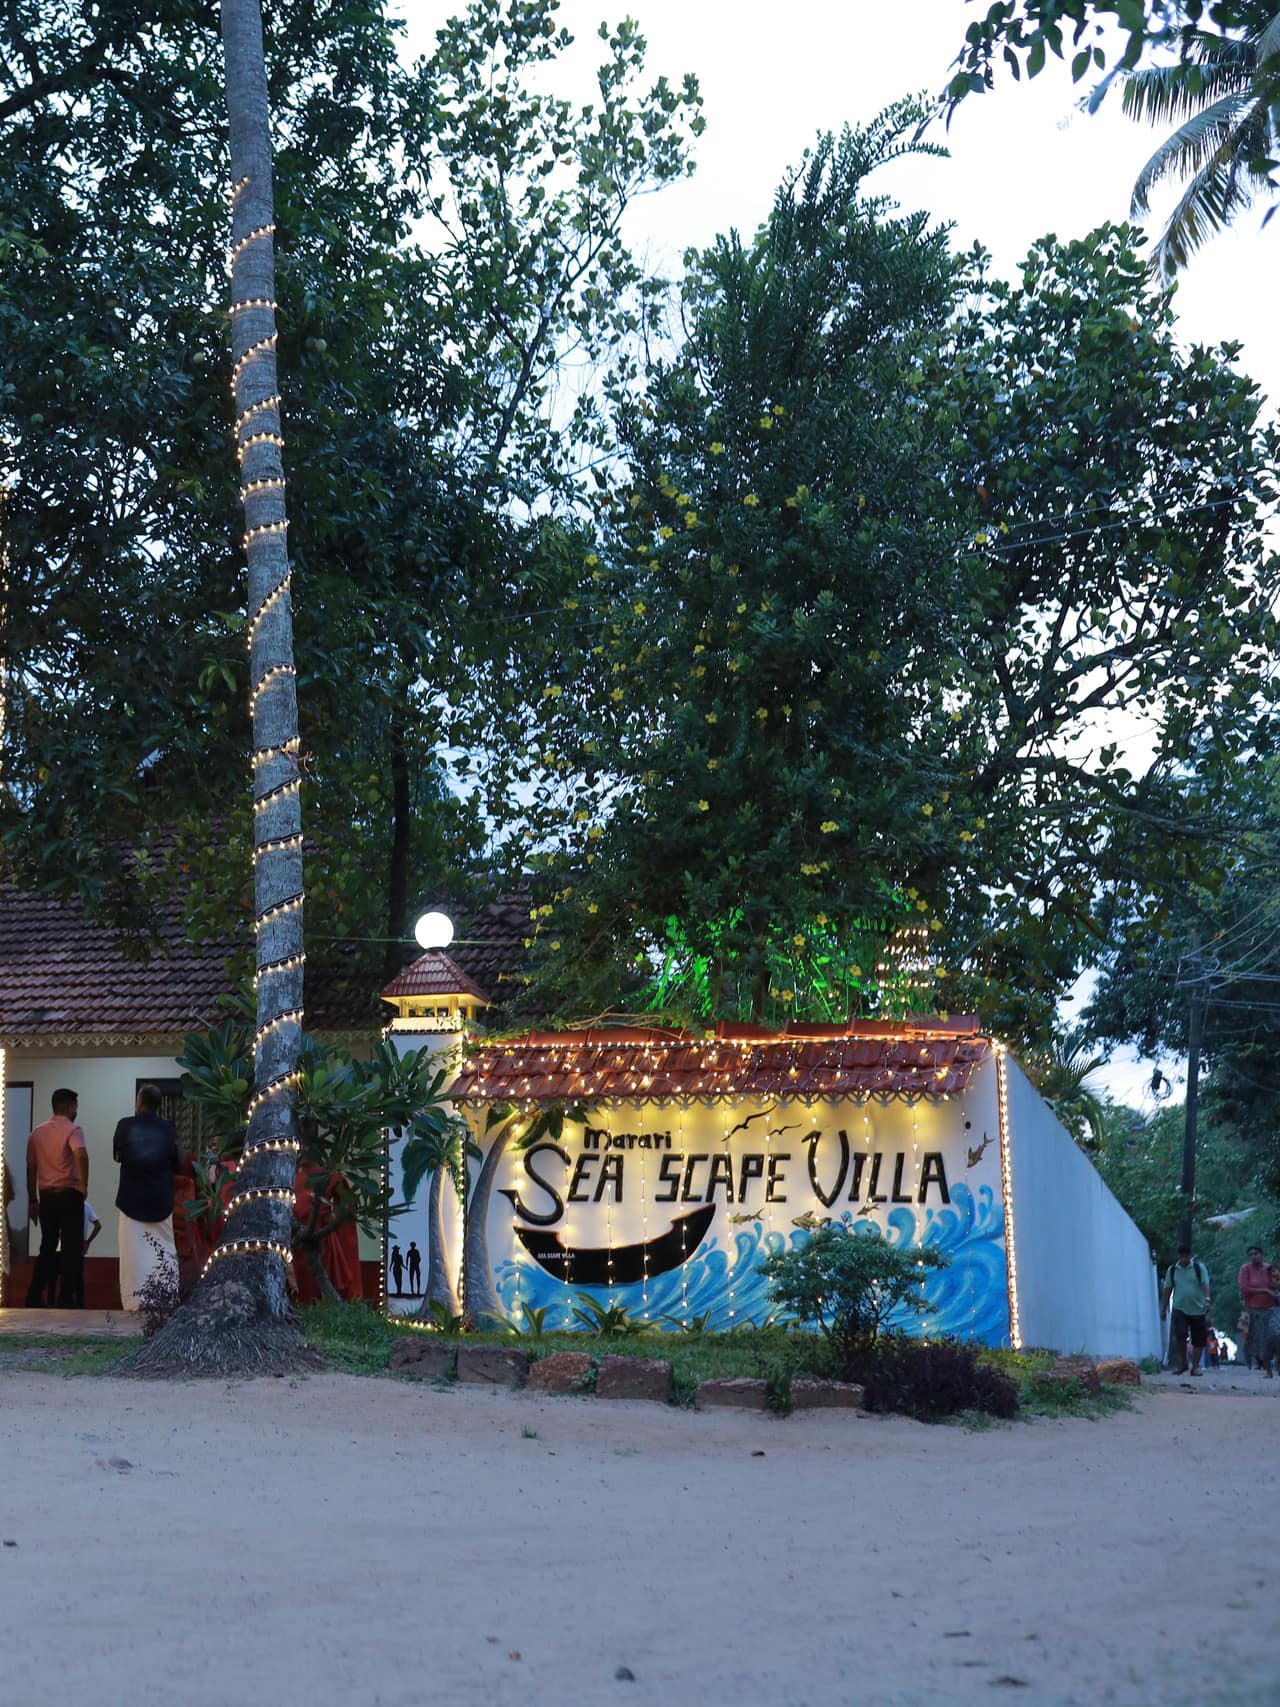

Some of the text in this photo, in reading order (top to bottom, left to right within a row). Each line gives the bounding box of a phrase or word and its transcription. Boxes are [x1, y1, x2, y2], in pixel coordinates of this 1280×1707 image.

[496, 1129, 951, 1227] SEA SCAPE VILLA
